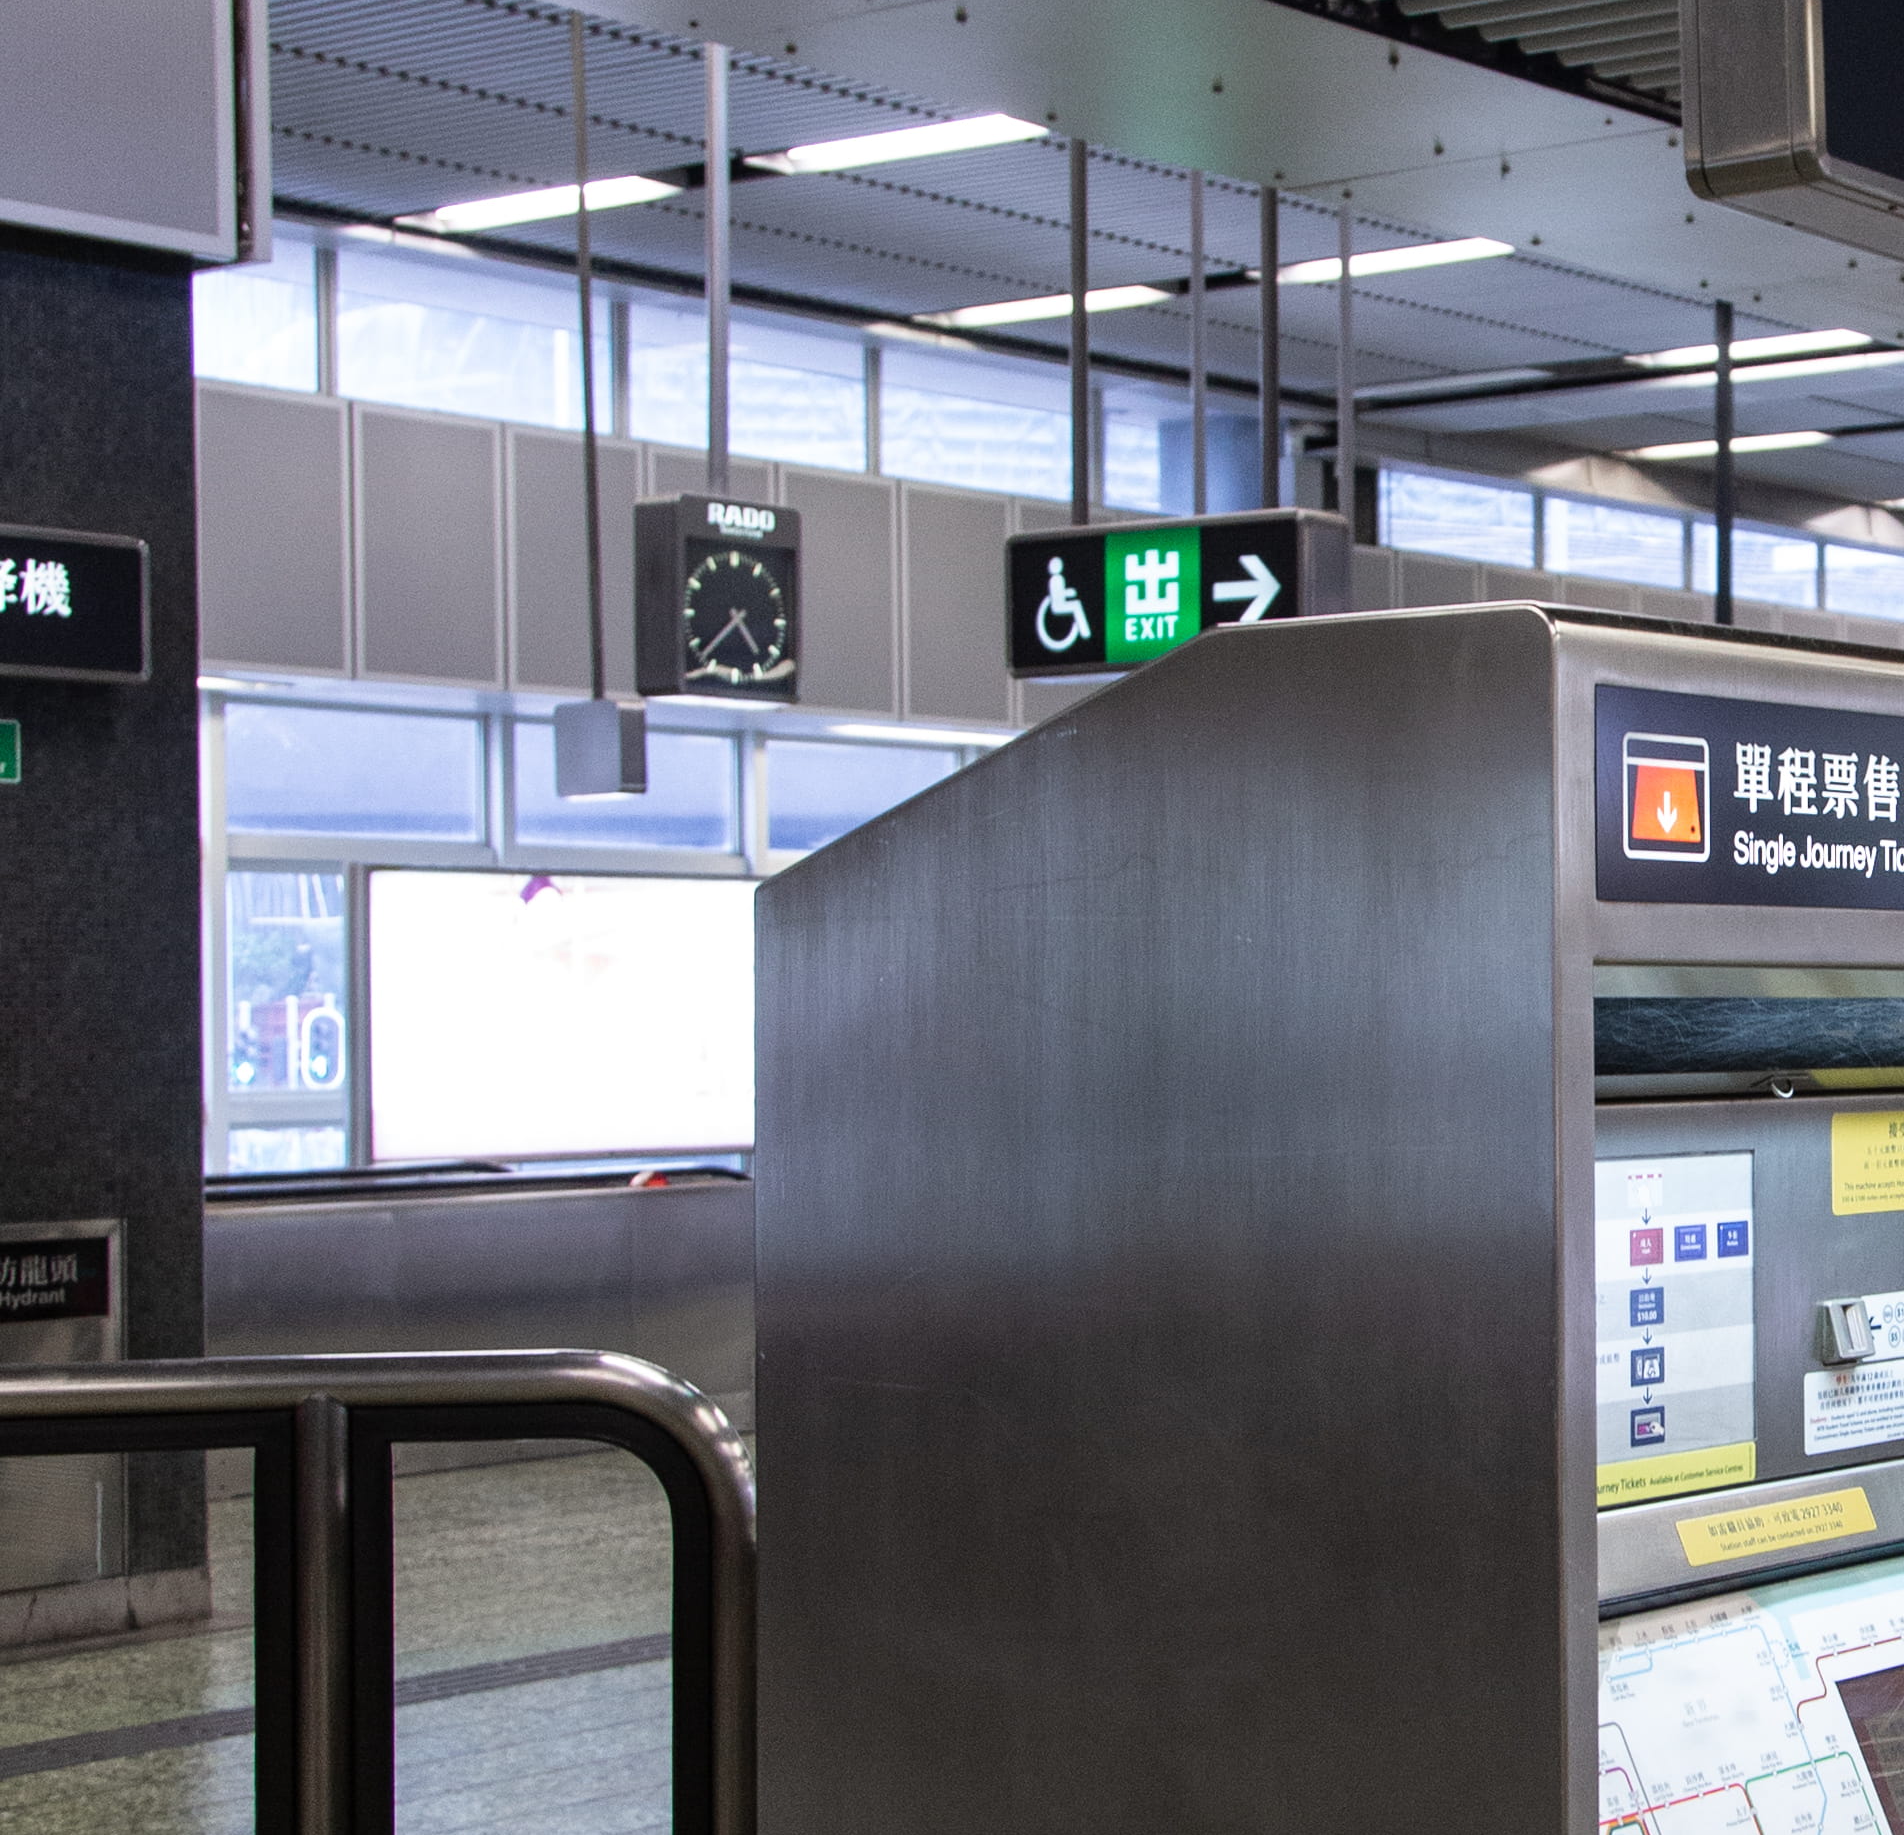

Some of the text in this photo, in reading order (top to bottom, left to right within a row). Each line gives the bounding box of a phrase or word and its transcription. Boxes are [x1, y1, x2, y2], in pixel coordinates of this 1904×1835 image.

[707, 502, 776, 533] RADO
[1125, 549, 1179, 615] 出
[1125, 615, 1179, 642] EXIT
[1733, 830, 1797, 874] Single
[1800, 835, 1877, 878] Journey
[1621, 1477, 1646, 1491] Tickets
[1801, 1504, 1822, 1521] 2927
[1823, 1501, 1844, 1517] 3340
